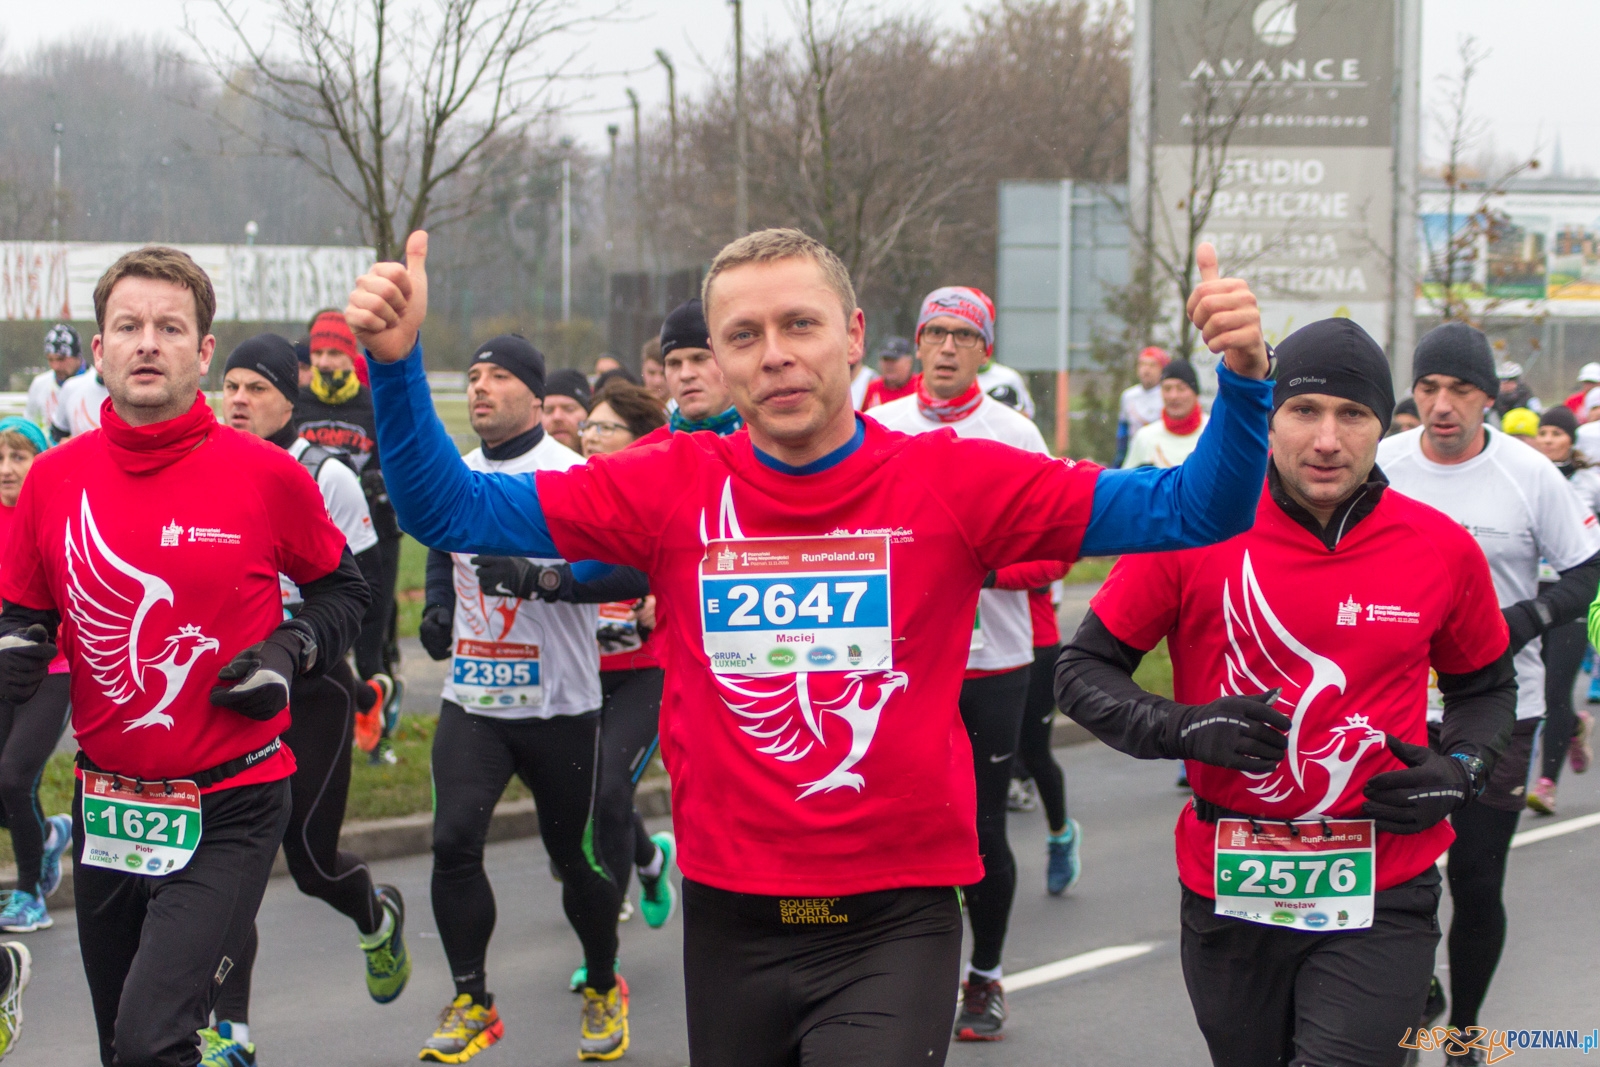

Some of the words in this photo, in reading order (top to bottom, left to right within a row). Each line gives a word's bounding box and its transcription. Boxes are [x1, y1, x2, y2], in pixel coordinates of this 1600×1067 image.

[1189, 58, 1361, 81] AVANCE
[1221, 158, 1325, 186] STUDIO
[188, 526, 196, 542] 1
[741, 552, 749, 566] 1
[801, 551, 875, 562] RunPoland.org
[707, 599, 720, 614] E
[727, 581, 868, 626] 2647
[1366, 604, 1375, 621] 1
[776, 633, 815, 644] Maciej
[714, 652, 741, 660] GRUPA
[714, 660, 747, 668] LUXMED
[463, 661, 531, 685] 2395
[87, 812, 95, 822] C
[100, 806, 187, 845] 1621
[90, 848, 109, 857] GRUPA
[135, 844, 153, 854] Piotr
[89, 855, 112, 863] LUXMED
[1220, 869, 1232, 881] C
[1237, 858, 1356, 895] 2576
[780, 898, 835, 908] SQUEEZY
[1274, 901, 1316, 909] Wiesław
[781, 907, 830, 917] SPORTS
[782, 914, 848, 924] NUTRITION
